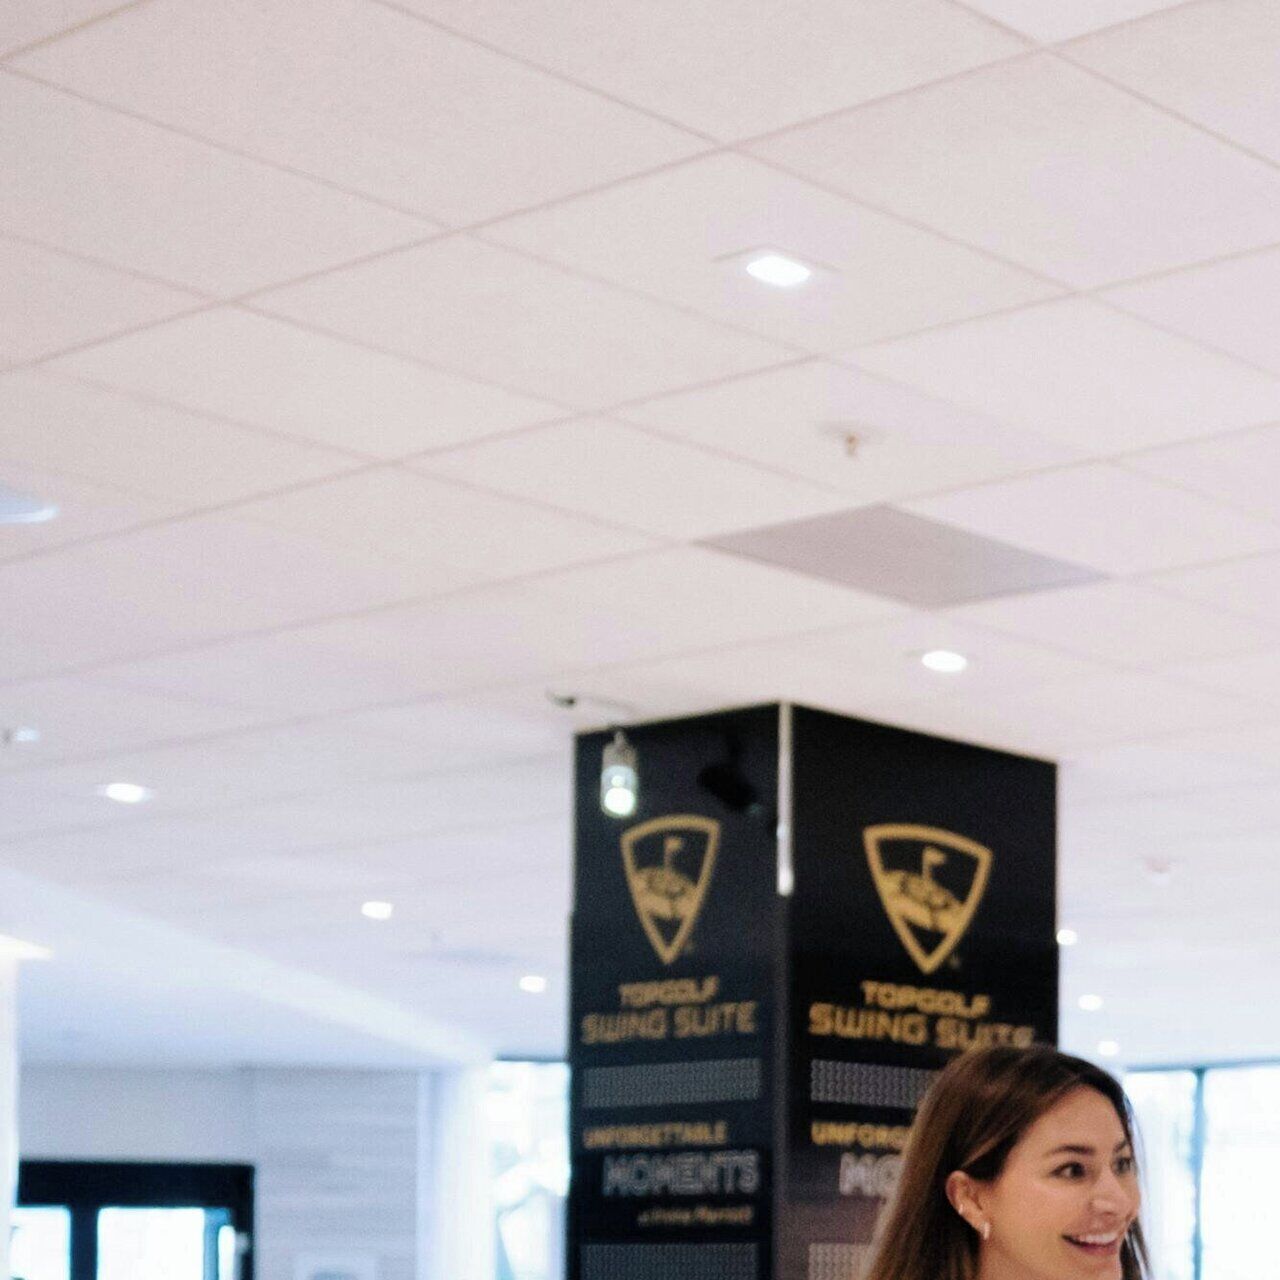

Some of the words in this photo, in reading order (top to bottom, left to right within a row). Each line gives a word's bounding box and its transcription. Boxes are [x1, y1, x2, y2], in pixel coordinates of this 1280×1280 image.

[619, 975, 719, 1008] TOPGOLF
[861, 980, 990, 1018] TOPGOLF
[582, 1007, 668, 1045] SWING
[674, 1000, 757, 1038] SUITE
[808, 1002, 928, 1046] SWING
[935, 1017, 1034, 1049] SUITE
[603, 1150, 760, 1197] MOMENTS
